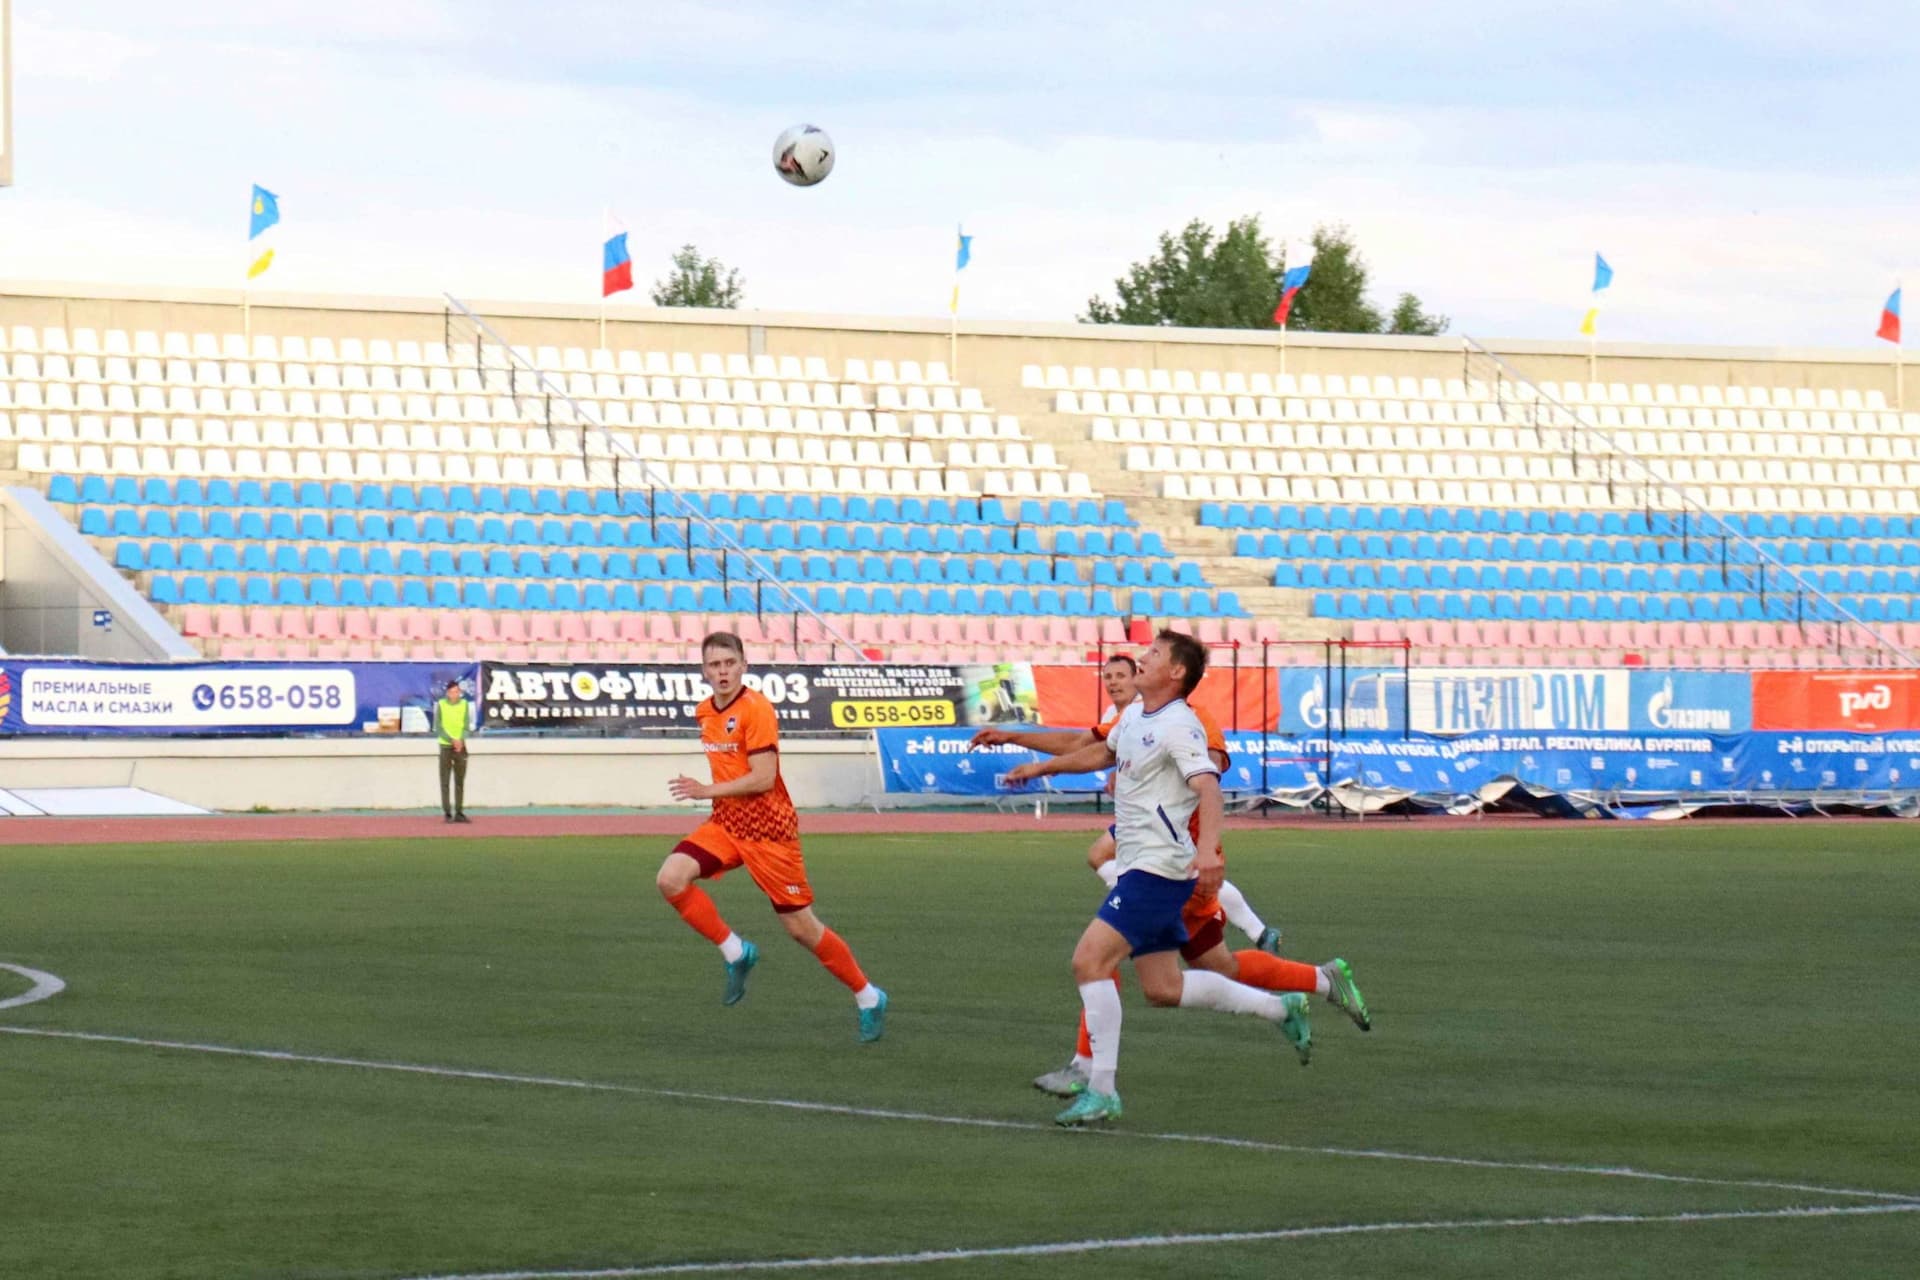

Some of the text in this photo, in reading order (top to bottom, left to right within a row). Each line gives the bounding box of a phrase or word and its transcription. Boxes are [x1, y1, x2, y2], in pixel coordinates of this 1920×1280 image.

[32, 681, 152, 695] ПРЕМИАЛЬНЫЕ
[219, 685, 341, 709] 658-058
[914, 687, 945, 697] АВТО
[32, 701, 173, 714] МАСЛА И СМАЗКИ
[488, 703, 619, 721] официальный
[625, 705, 678, 720] дилер
[863, 704, 946, 723] 658-058
[906, 735, 936, 755] 2-Й
[1501, 737, 1544, 751] ЭТАП.
[1546, 737, 1642, 752] РЕСПУБЛИКА
[1644, 738, 1712, 753] БУРЯТИЯ
[1777, 735, 1803, 754] 2-Й
[1805, 735, 1885, 753] ОТКРЫТЫЙ
